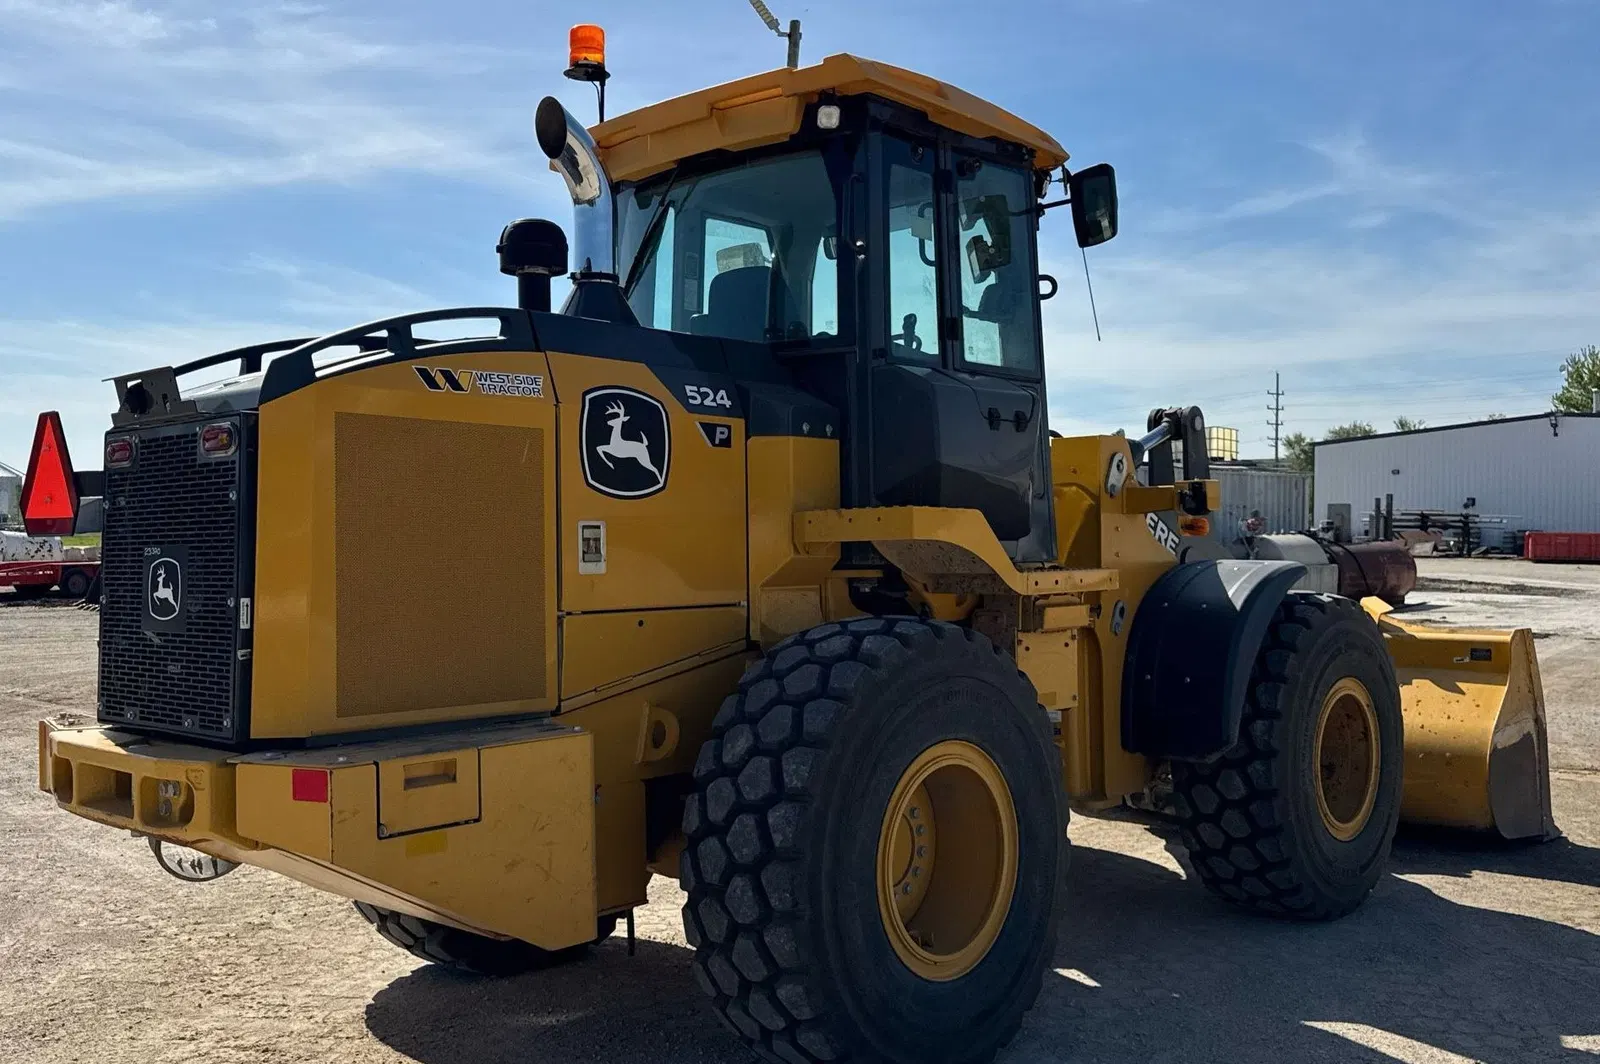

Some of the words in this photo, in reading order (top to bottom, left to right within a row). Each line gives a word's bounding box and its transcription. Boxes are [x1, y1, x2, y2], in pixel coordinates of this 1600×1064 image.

[475, 371, 511, 385] WEST
[515, 375, 543, 387] SIDE
[479, 383, 543, 397] TRACTOR
[684, 384, 732, 408] 524
[715, 426, 729, 445] P
